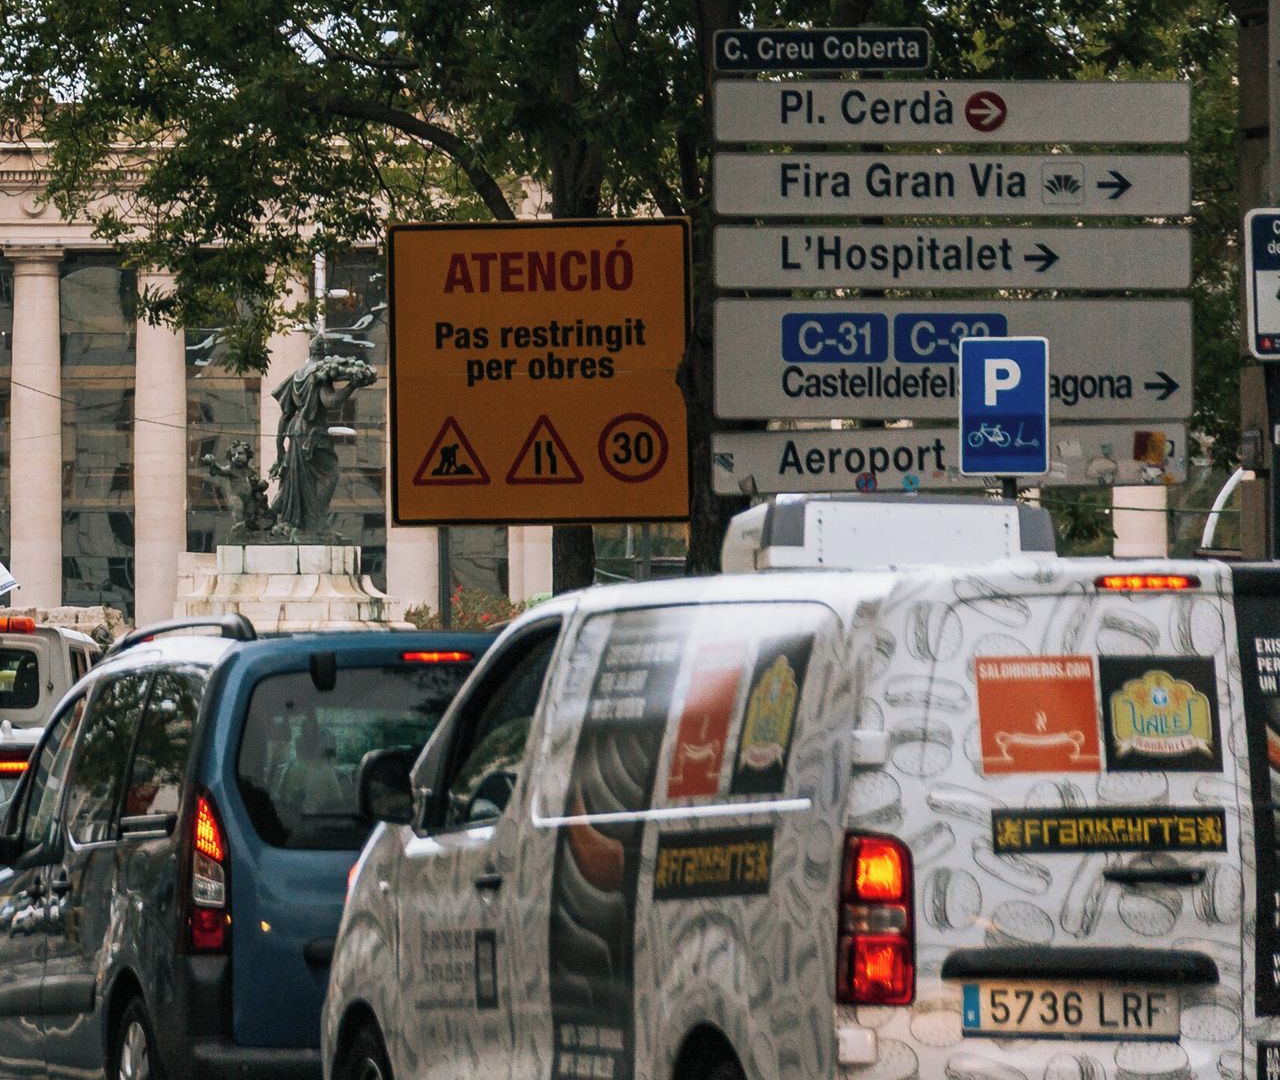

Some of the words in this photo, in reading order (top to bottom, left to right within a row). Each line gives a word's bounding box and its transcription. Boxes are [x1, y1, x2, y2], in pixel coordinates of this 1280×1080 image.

[724, 37, 748, 59] C.
[757, 37, 814, 59] Creu
[823, 36, 920, 59] Coberta
[781, 90, 825, 124] Pl.
[841, 89, 953, 125] Cerdà
[781, 162, 850, 197] Fira
[866, 162, 955, 197] Gran
[969, 162, 1026, 197] Via
[443, 239, 634, 294] ATENCIÓ
[781, 235, 1013, 278] L'Hospitalet
[435, 322, 489, 349] Pas
[500, 318, 646, 353] restringit
[798, 320, 872, 356] C-31
[467, 358, 516, 387] per
[529, 352, 615, 380] obres
[782, 365, 960, 399] Castelldefel
[1049, 373, 1132, 406] agona
[984, 358, 1022, 407] P
[612, 431, 654, 465] 30
[779, 437, 946, 478] Aeroport
[991, 989, 1083, 1026] 5736
[1098, 991, 1167, 1028] LRF
